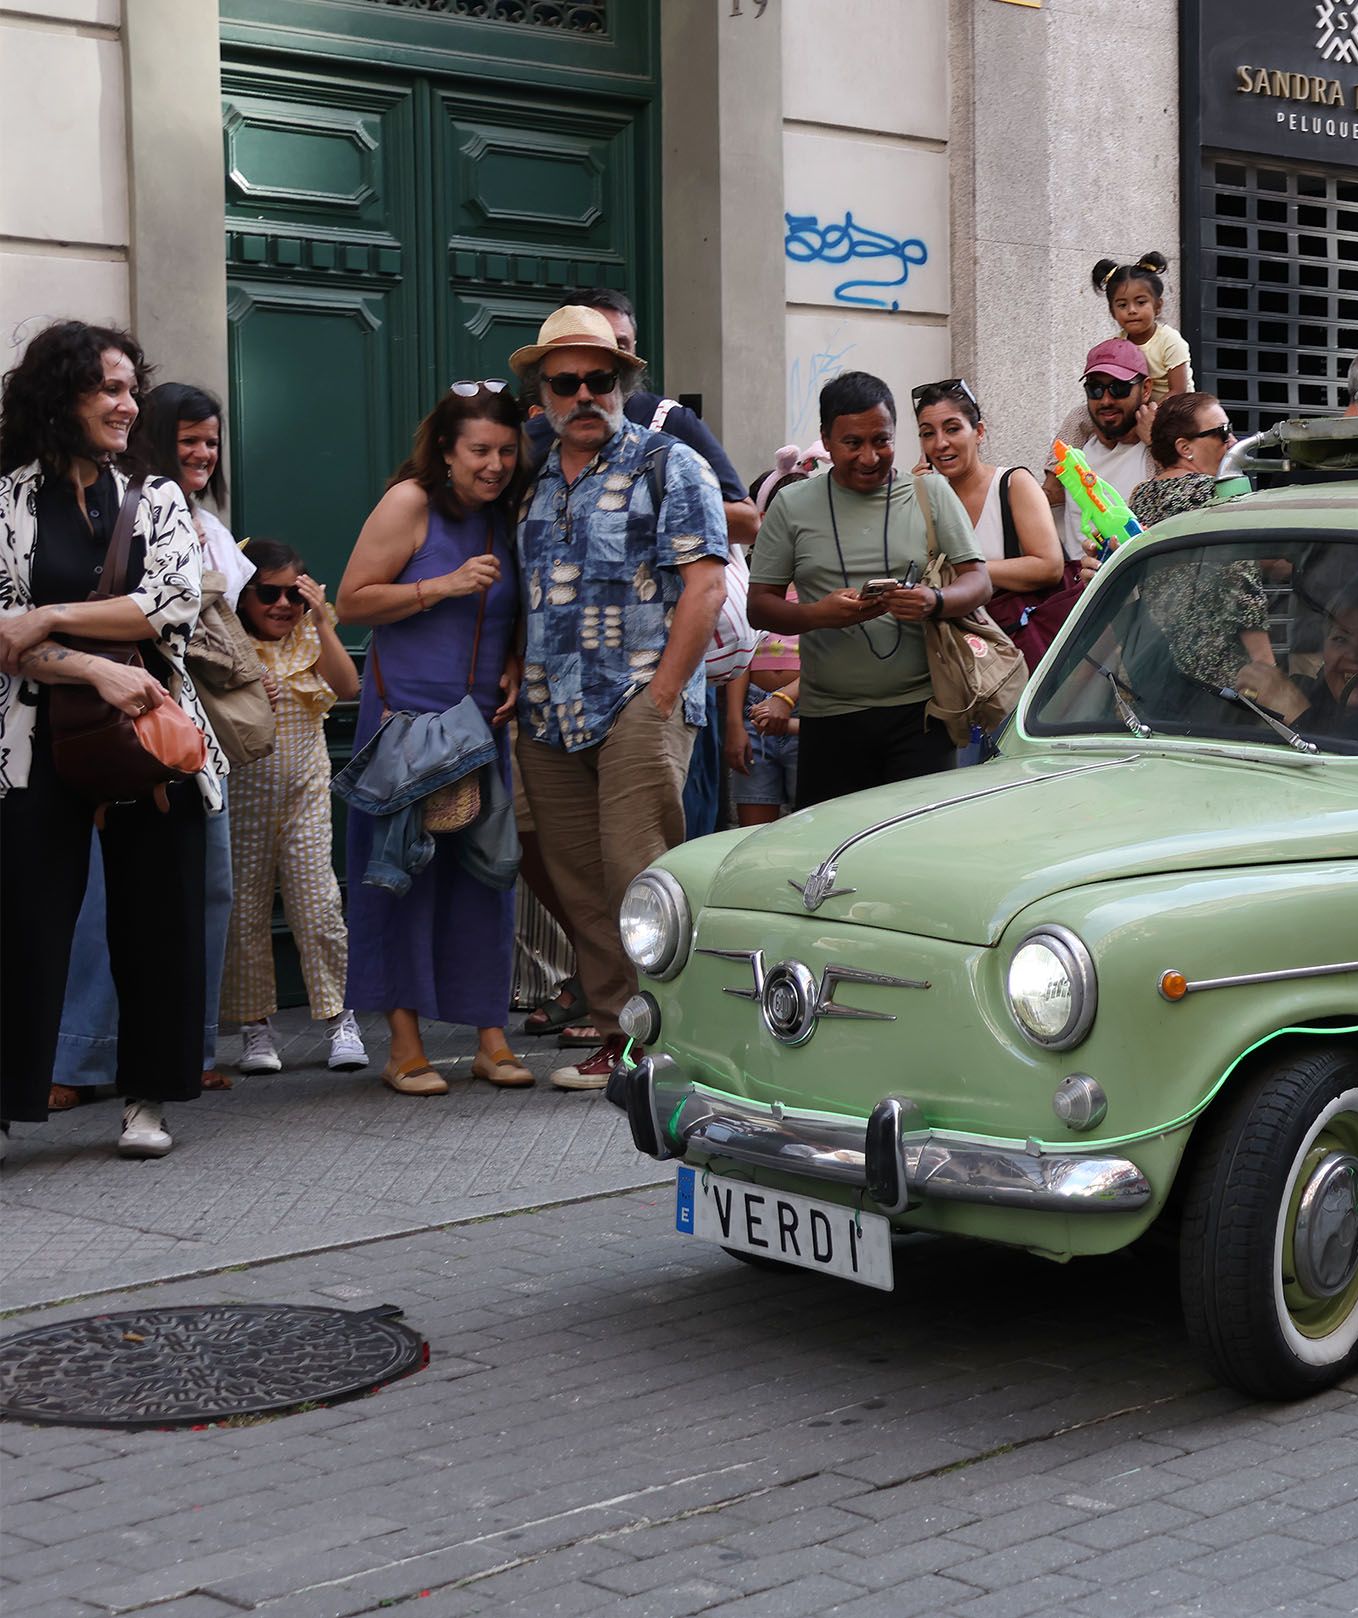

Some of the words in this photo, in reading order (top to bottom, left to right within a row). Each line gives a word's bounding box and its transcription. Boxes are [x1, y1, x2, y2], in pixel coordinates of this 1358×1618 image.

[1236, 65, 1345, 106] SANDRA
[680, 1207, 690, 1223] E
[713, 1184, 859, 1273] VERDI
